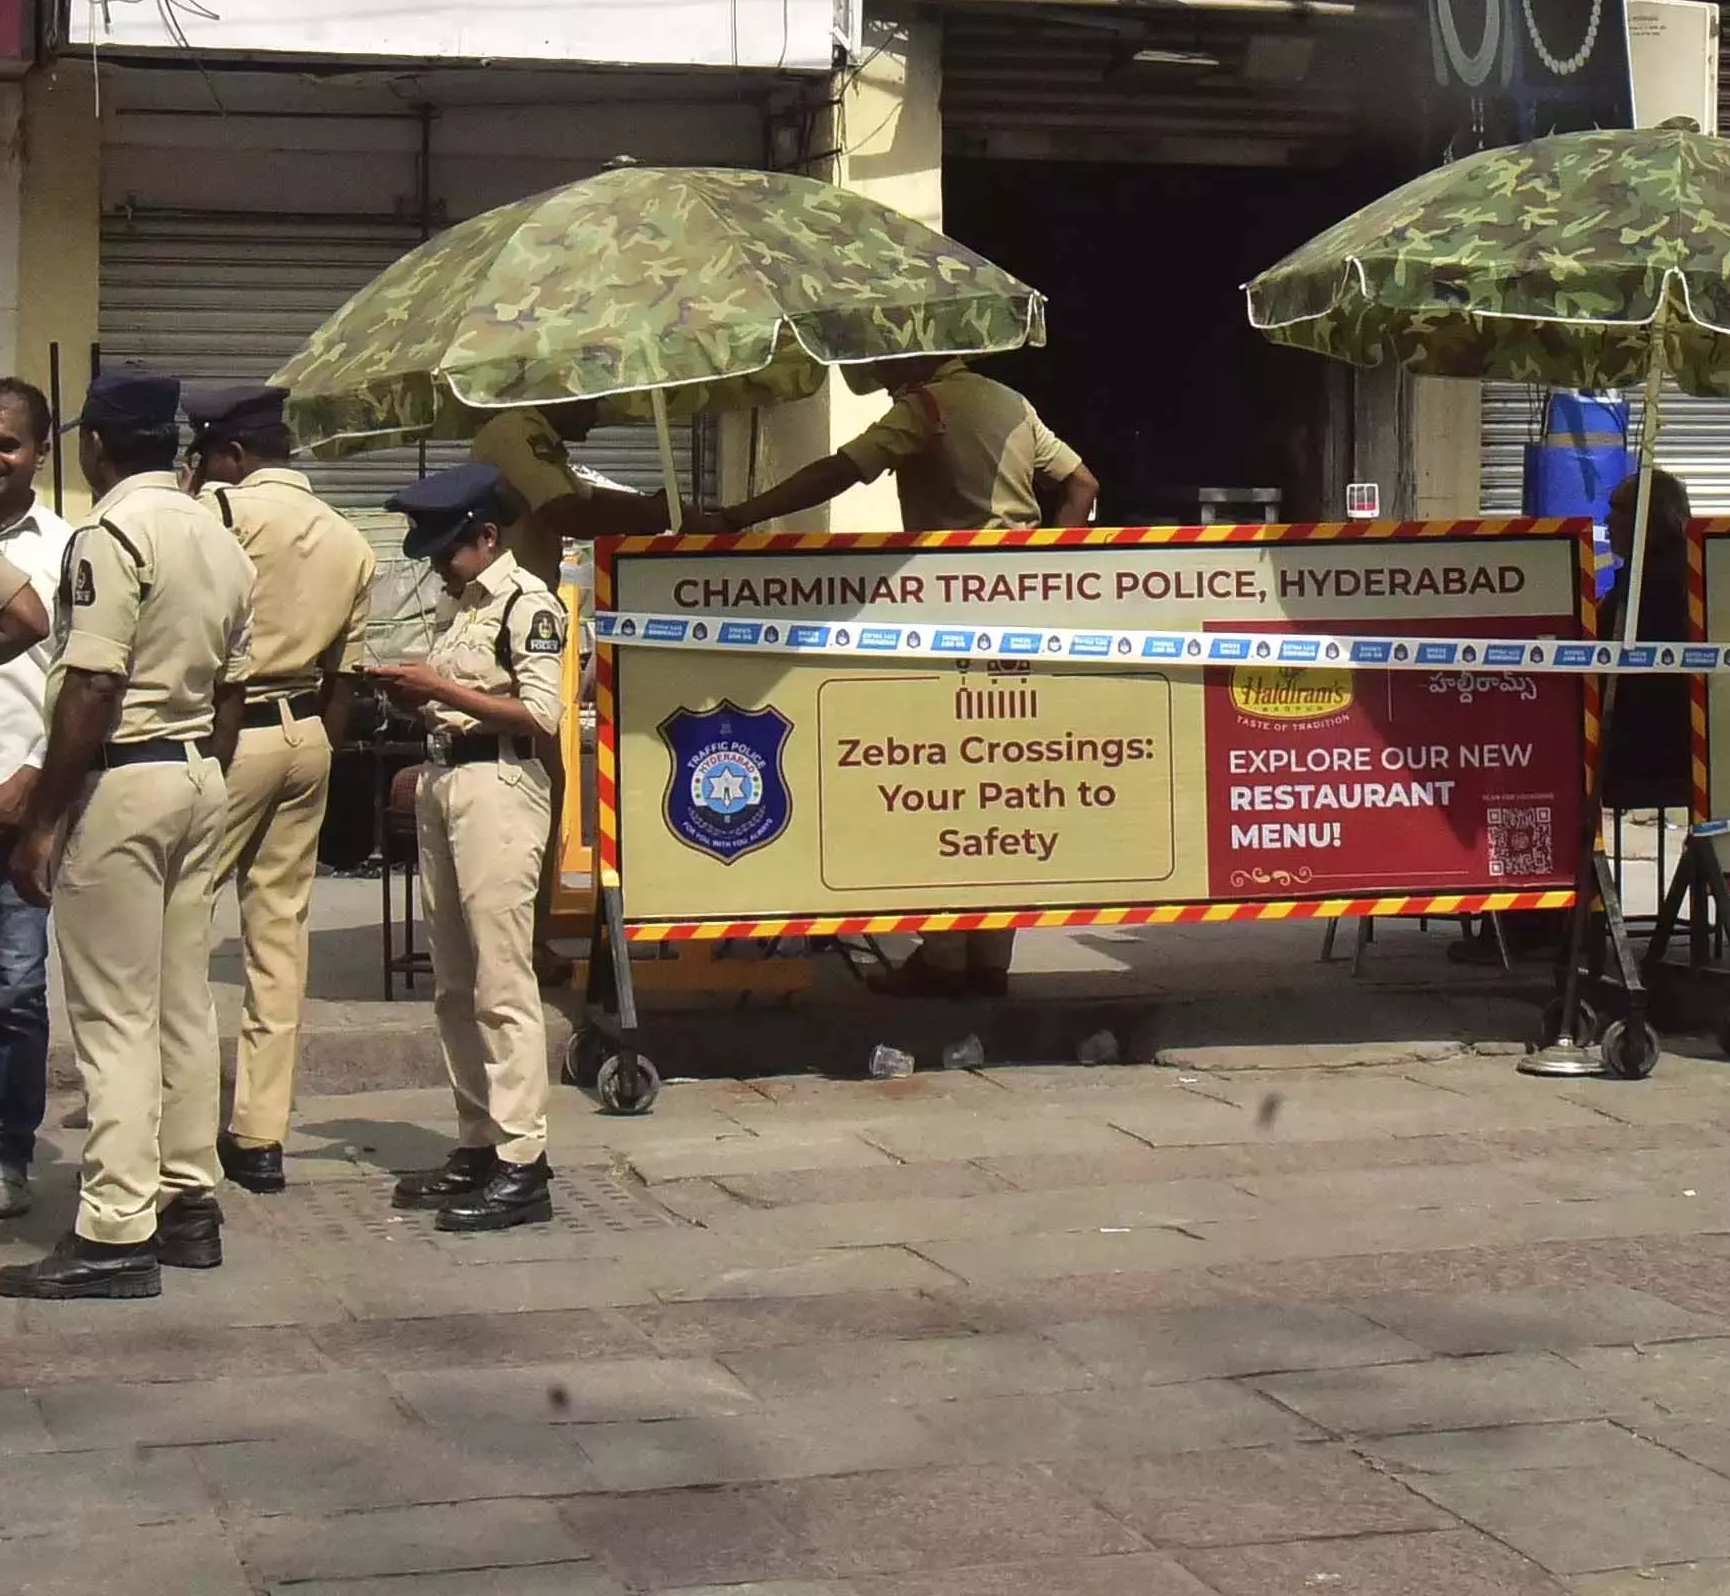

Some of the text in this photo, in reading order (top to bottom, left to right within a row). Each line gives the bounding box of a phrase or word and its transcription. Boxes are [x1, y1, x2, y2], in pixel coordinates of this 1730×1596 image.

[673, 565, 1525, 610] CHARMINAR TRAFFIC POLICE, HYDERABAD
[1241, 675, 1346, 707] Haldiram's
[1236, 713, 1352, 732] TASTE OF TRADITION
[686, 741, 767, 770] TRAFFIC POLICE
[698, 752, 756, 775] HYDERABAD
[836, 733, 1154, 774] Zebra Crossings:
[1229, 743, 1534, 775] EXPLORE OUR NEW
[877, 777, 1116, 813] Your Path to
[1230, 781, 1455, 811] RESTAURANT
[712, 838, 732, 849] WITH
[936, 825, 1060, 863] Safety
[1230, 822, 1342, 850] MENU!
